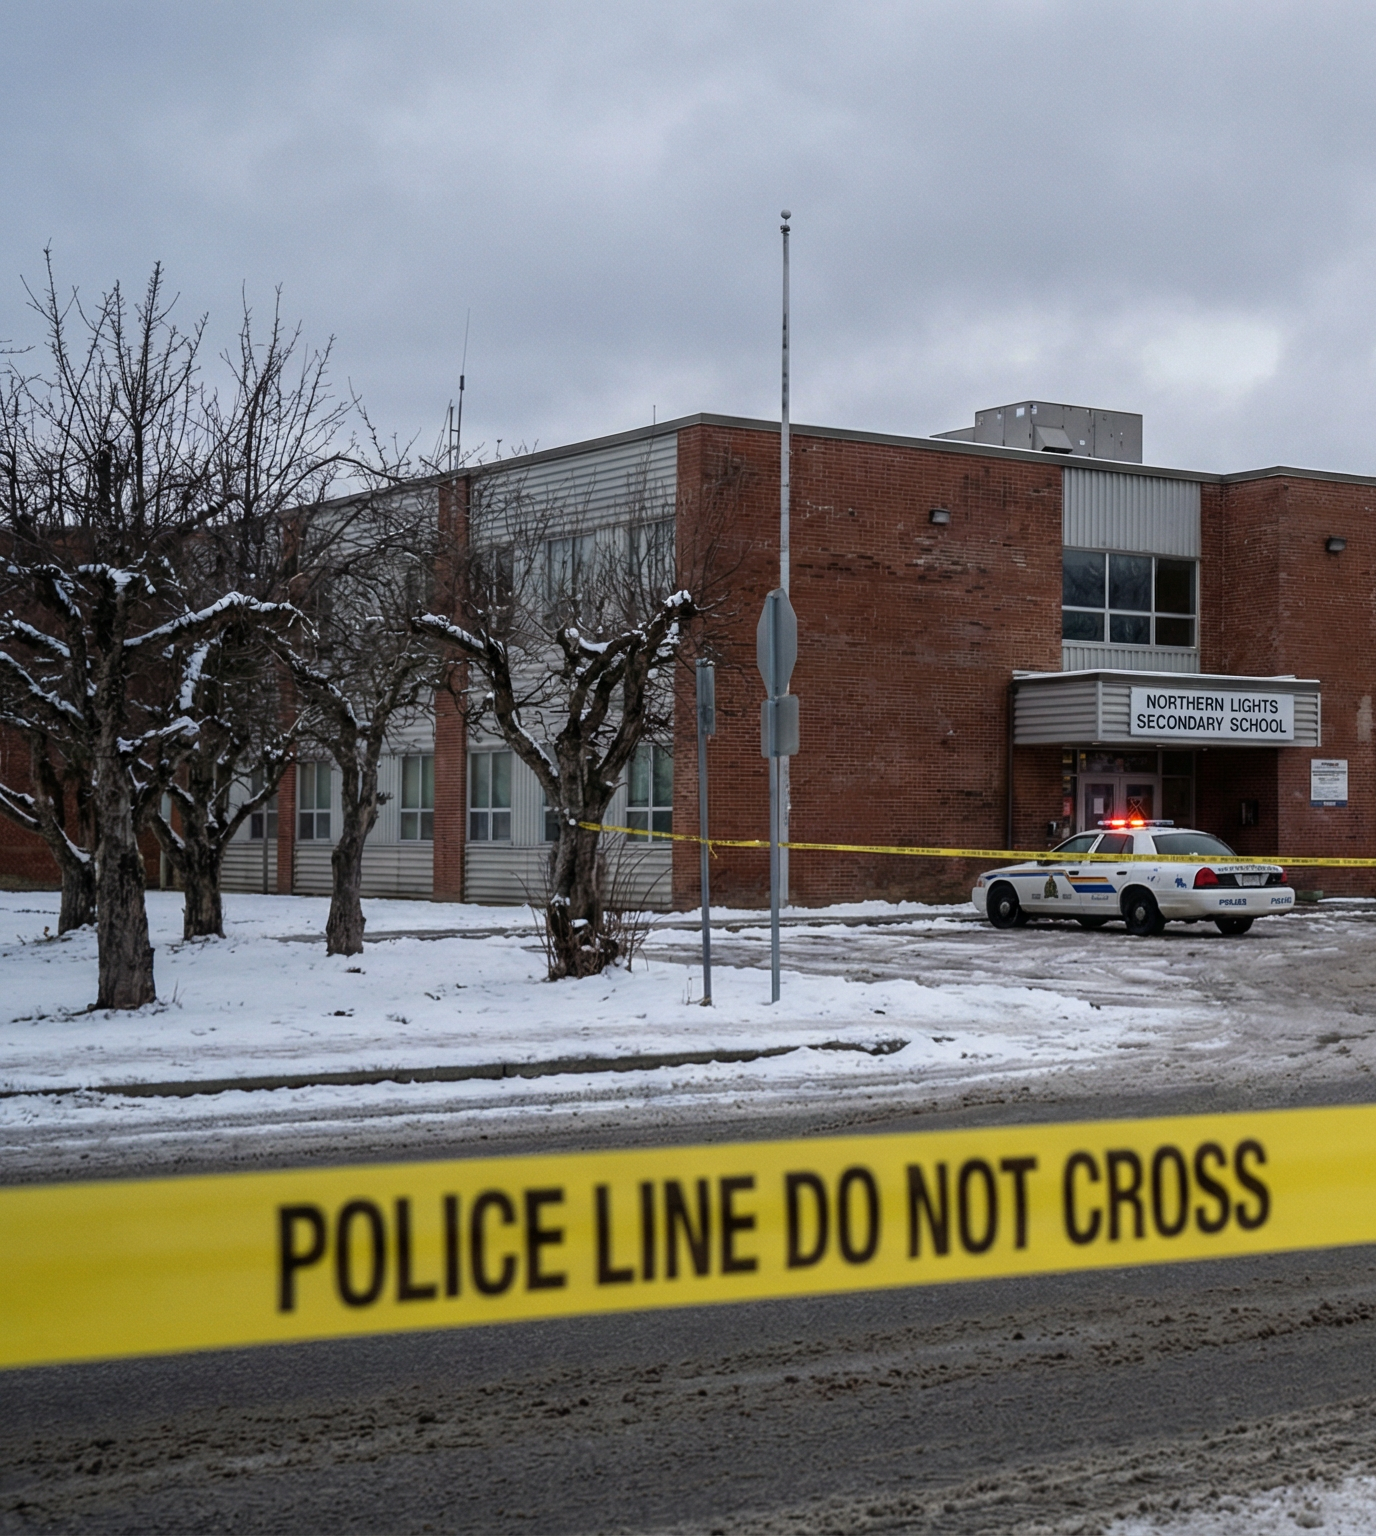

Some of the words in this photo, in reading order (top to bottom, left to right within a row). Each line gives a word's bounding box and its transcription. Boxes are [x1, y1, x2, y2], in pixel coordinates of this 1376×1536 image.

[1146, 694, 1225, 712] NORTHERN
[1230, 697, 1279, 714] LIGHTS
[1136, 713, 1224, 731] SECONDARY
[1229, 717, 1287, 734] SCHOOL
[276, 1186, 568, 1315] POLICE
[593, 1174, 760, 1287] LINE
[783, 1165, 883, 1270] DO
[906, 1156, 1039, 1260] NOT
[1062, 1138, 1272, 1246] CROSS
